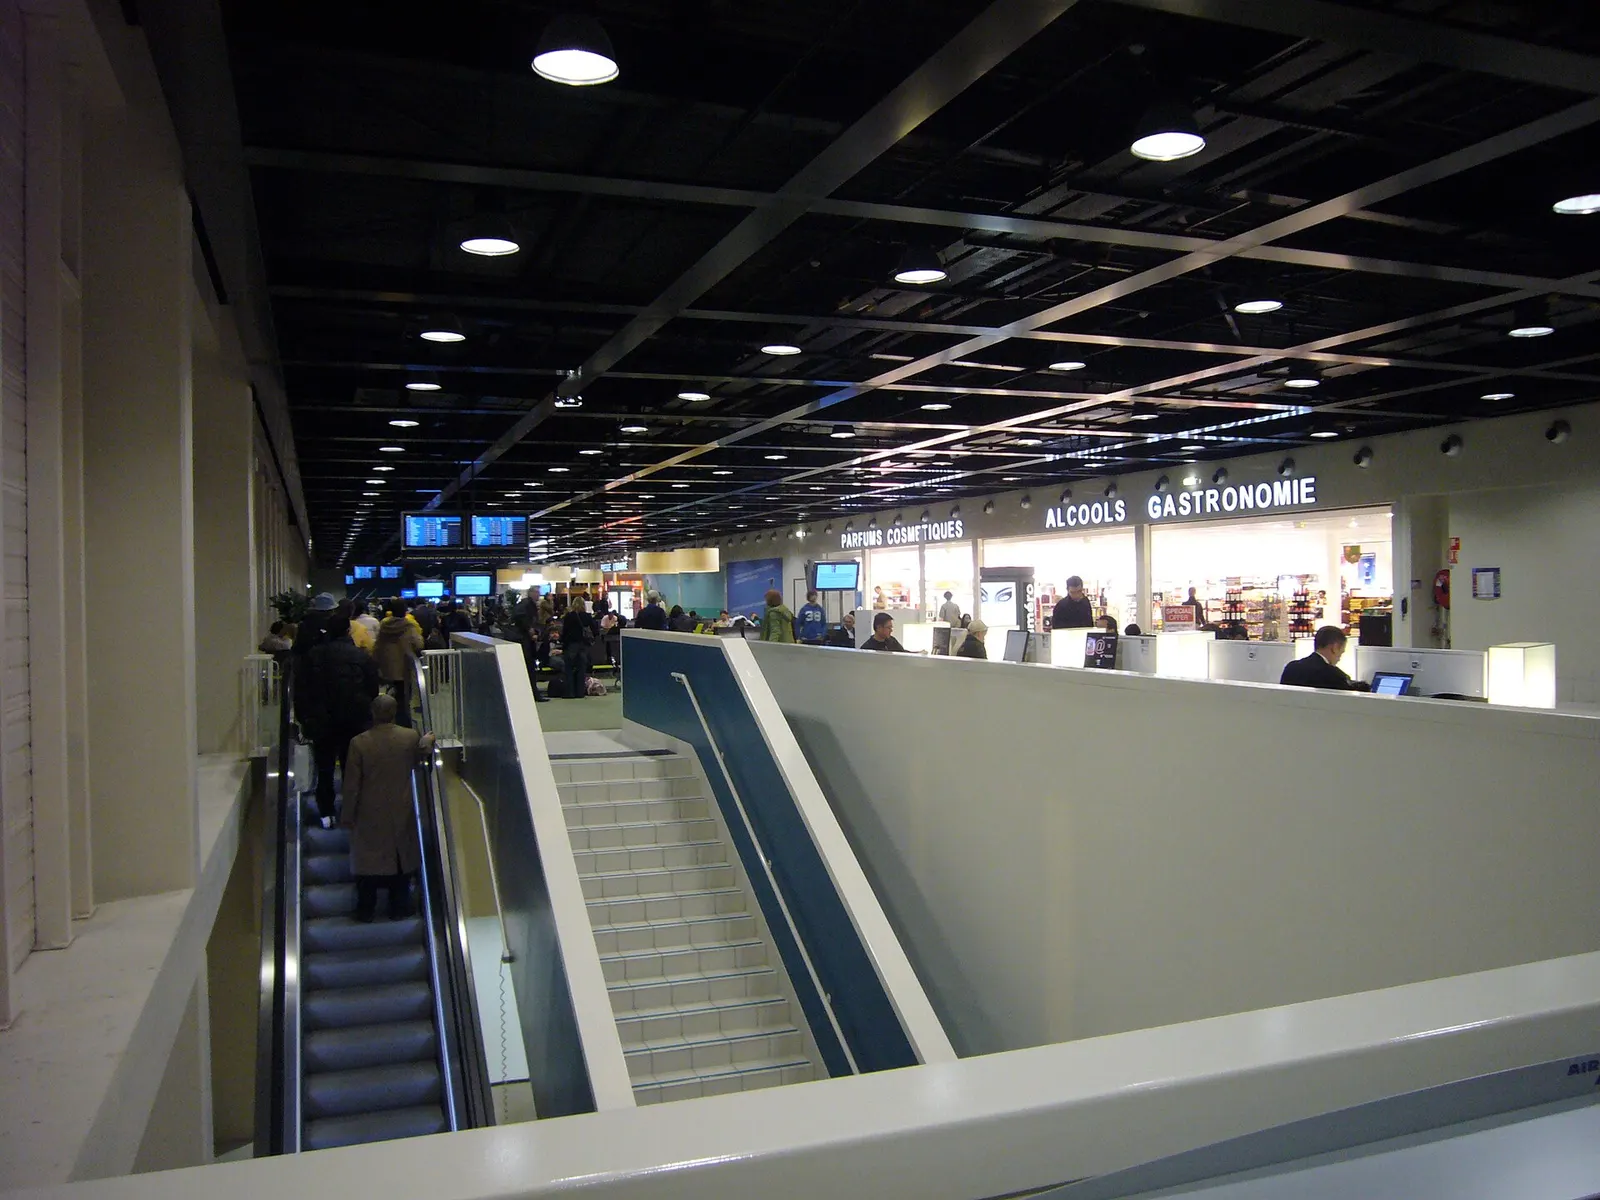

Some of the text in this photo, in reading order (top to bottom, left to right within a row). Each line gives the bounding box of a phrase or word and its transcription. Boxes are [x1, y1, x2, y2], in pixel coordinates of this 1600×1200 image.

[1148, 477, 1316, 519] GASTRONOMIE
[1045, 500, 1126, 529] ALCOOLS
[841, 520, 964, 549] PARFUMS COSMETIQUES
